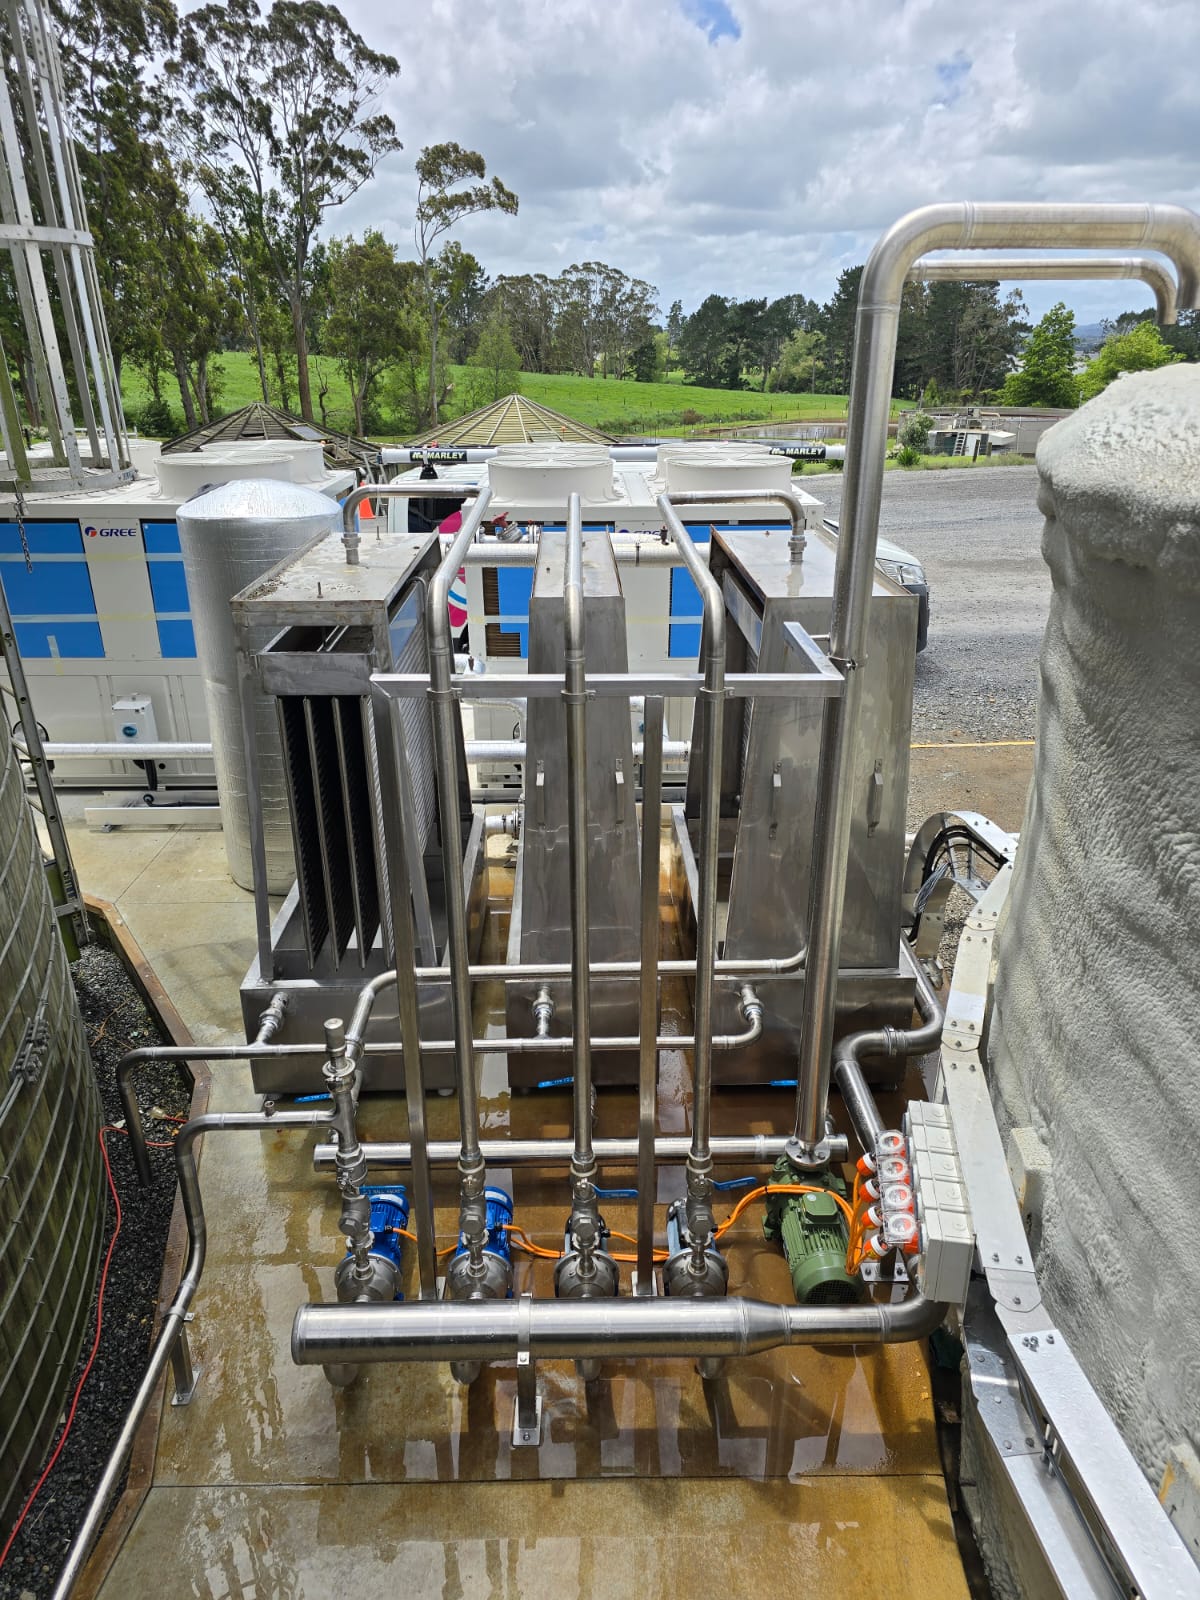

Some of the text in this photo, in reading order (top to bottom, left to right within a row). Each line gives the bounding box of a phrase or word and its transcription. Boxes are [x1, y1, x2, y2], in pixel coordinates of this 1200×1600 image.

[427, 451, 464, 459] MARLEY
[786, 447, 824, 455] MARLEY
[100, 528, 137, 537] GREE
